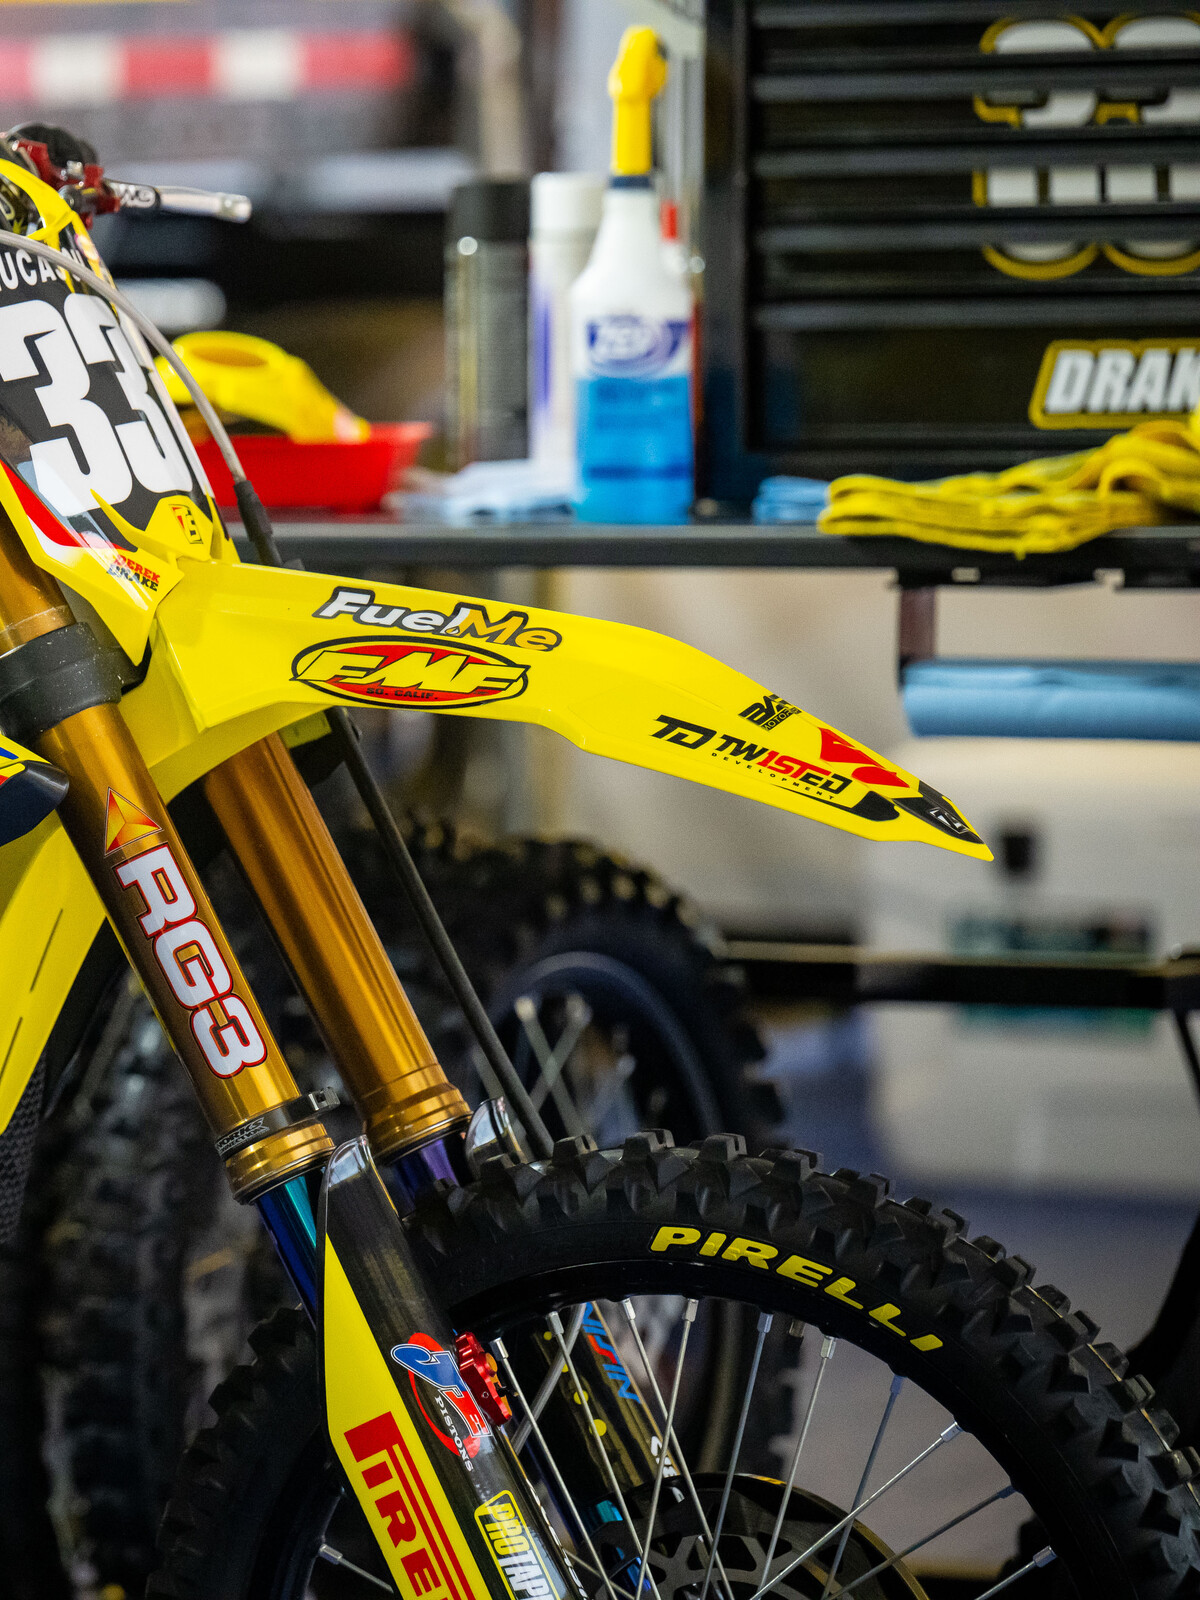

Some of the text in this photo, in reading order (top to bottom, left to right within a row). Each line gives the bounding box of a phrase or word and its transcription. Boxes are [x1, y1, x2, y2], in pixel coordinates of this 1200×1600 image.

[113, 554, 160, 584] DEREK
[294, 649, 530, 695] FMF
[366, 686, 438, 700] SO. CALIF.
[711, 752, 835, 800] DEVELOPMENT
[113, 843, 267, 1078] RG3
[650, 1226, 944, 1352] PIRELLI
[435, 1395, 474, 1472] PISTONS
[344, 1411, 470, 1600] PIRE
[478, 1502, 556, 1600] PROTAP
